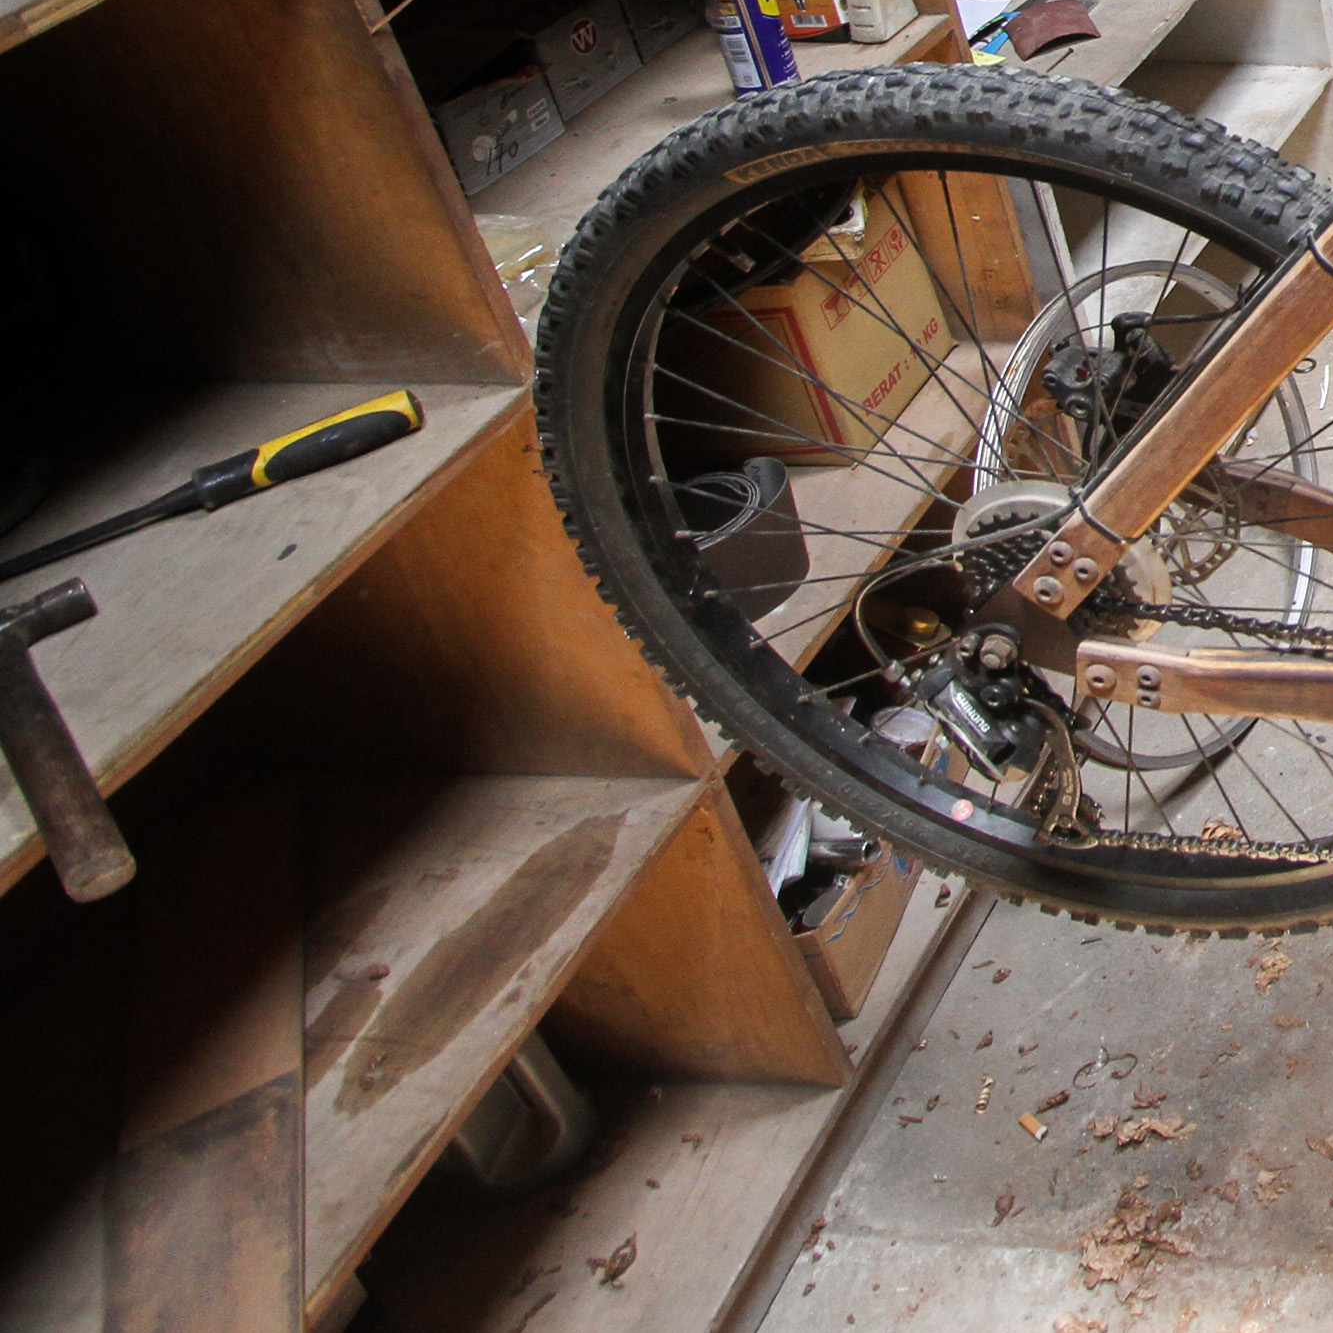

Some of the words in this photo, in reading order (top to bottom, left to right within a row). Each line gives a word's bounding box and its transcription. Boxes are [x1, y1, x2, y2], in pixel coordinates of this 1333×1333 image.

[570, 26, 598, 52] W
[735, 145, 824, 181] KENDA
[861, 362, 903, 418] BERAT
[923, 317, 940, 347] KG
[955, 692, 991, 733] SHIMANO
